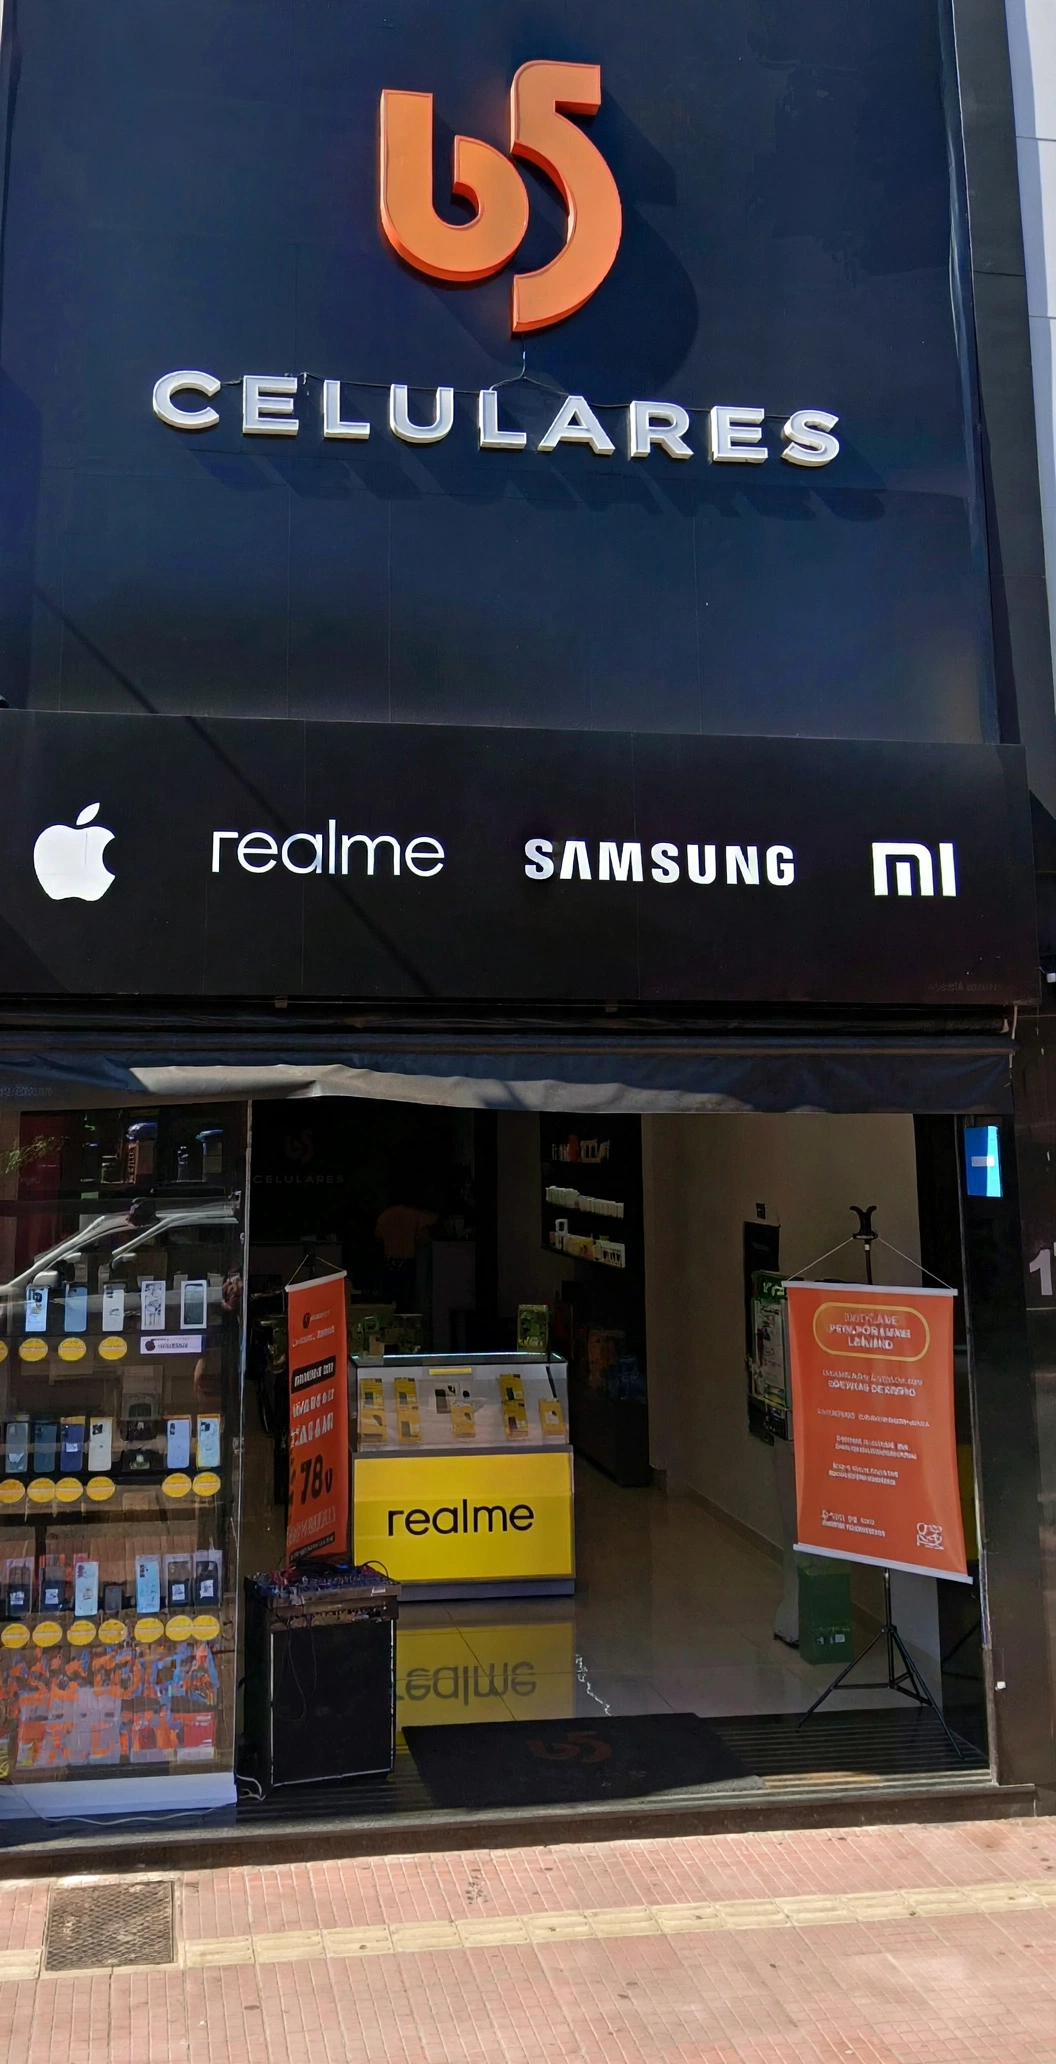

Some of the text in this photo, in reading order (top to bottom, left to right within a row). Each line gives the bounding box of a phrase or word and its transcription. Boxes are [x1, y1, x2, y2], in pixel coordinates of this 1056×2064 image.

[152, 370, 840, 467] CELULARES
[212, 820, 445, 879] realme
[524, 838, 796, 887] SAMSUNG
[253, 1174, 344, 1184] CELULARES
[388, 1499, 534, 1536] realme
